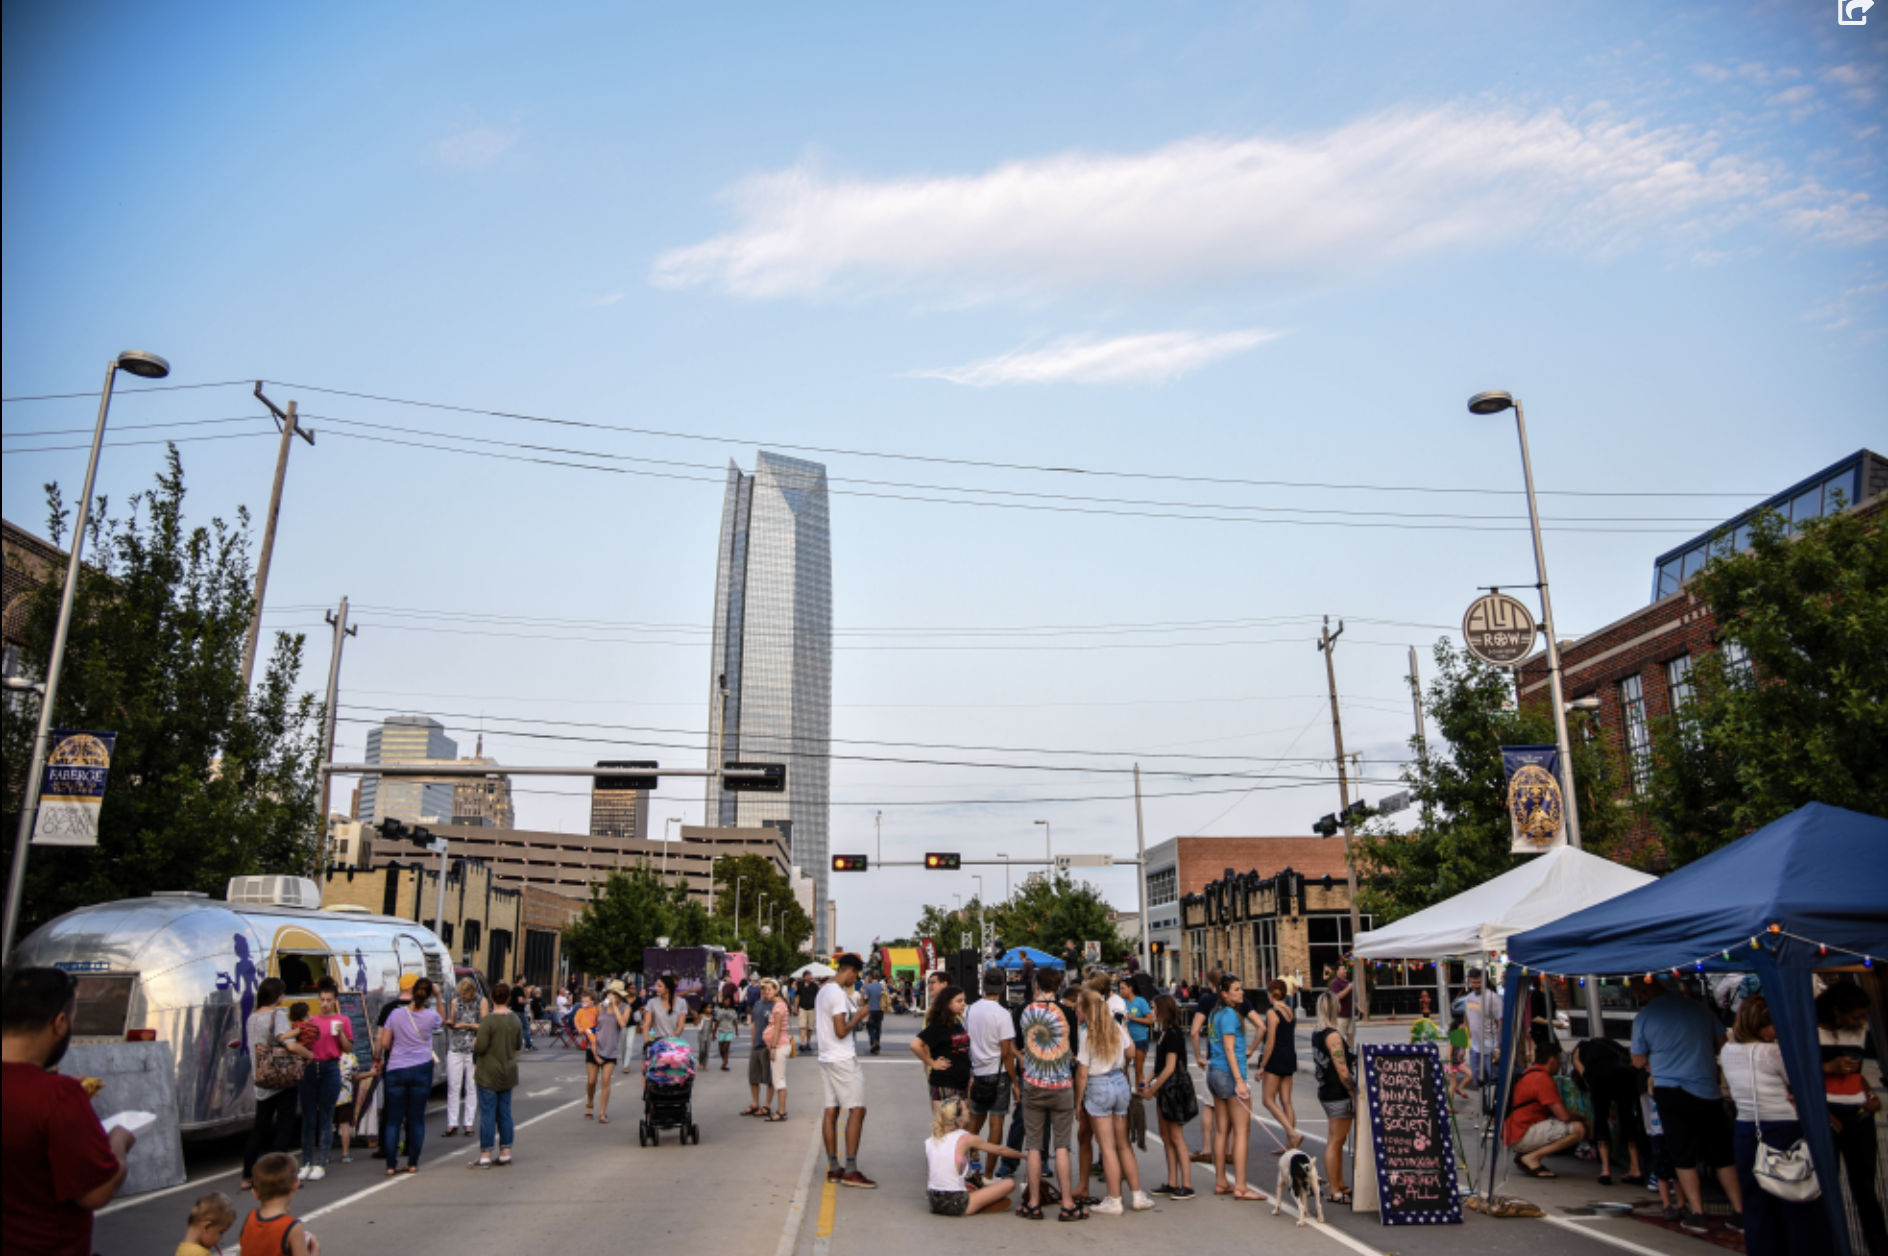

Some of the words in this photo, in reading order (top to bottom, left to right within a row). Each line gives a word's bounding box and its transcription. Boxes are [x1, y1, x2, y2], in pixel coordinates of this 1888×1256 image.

[1483, 632, 1520, 647] ROW
[42, 821, 62, 834] OF
[1375, 1056, 1425, 1079] COUNTRY
[1379, 1072, 1422, 1090] ROADS
[1379, 1088, 1428, 1104] ANIMAL
[1381, 1102, 1430, 1117] RESCUE
[1405, 1184, 1439, 1200] ALL
